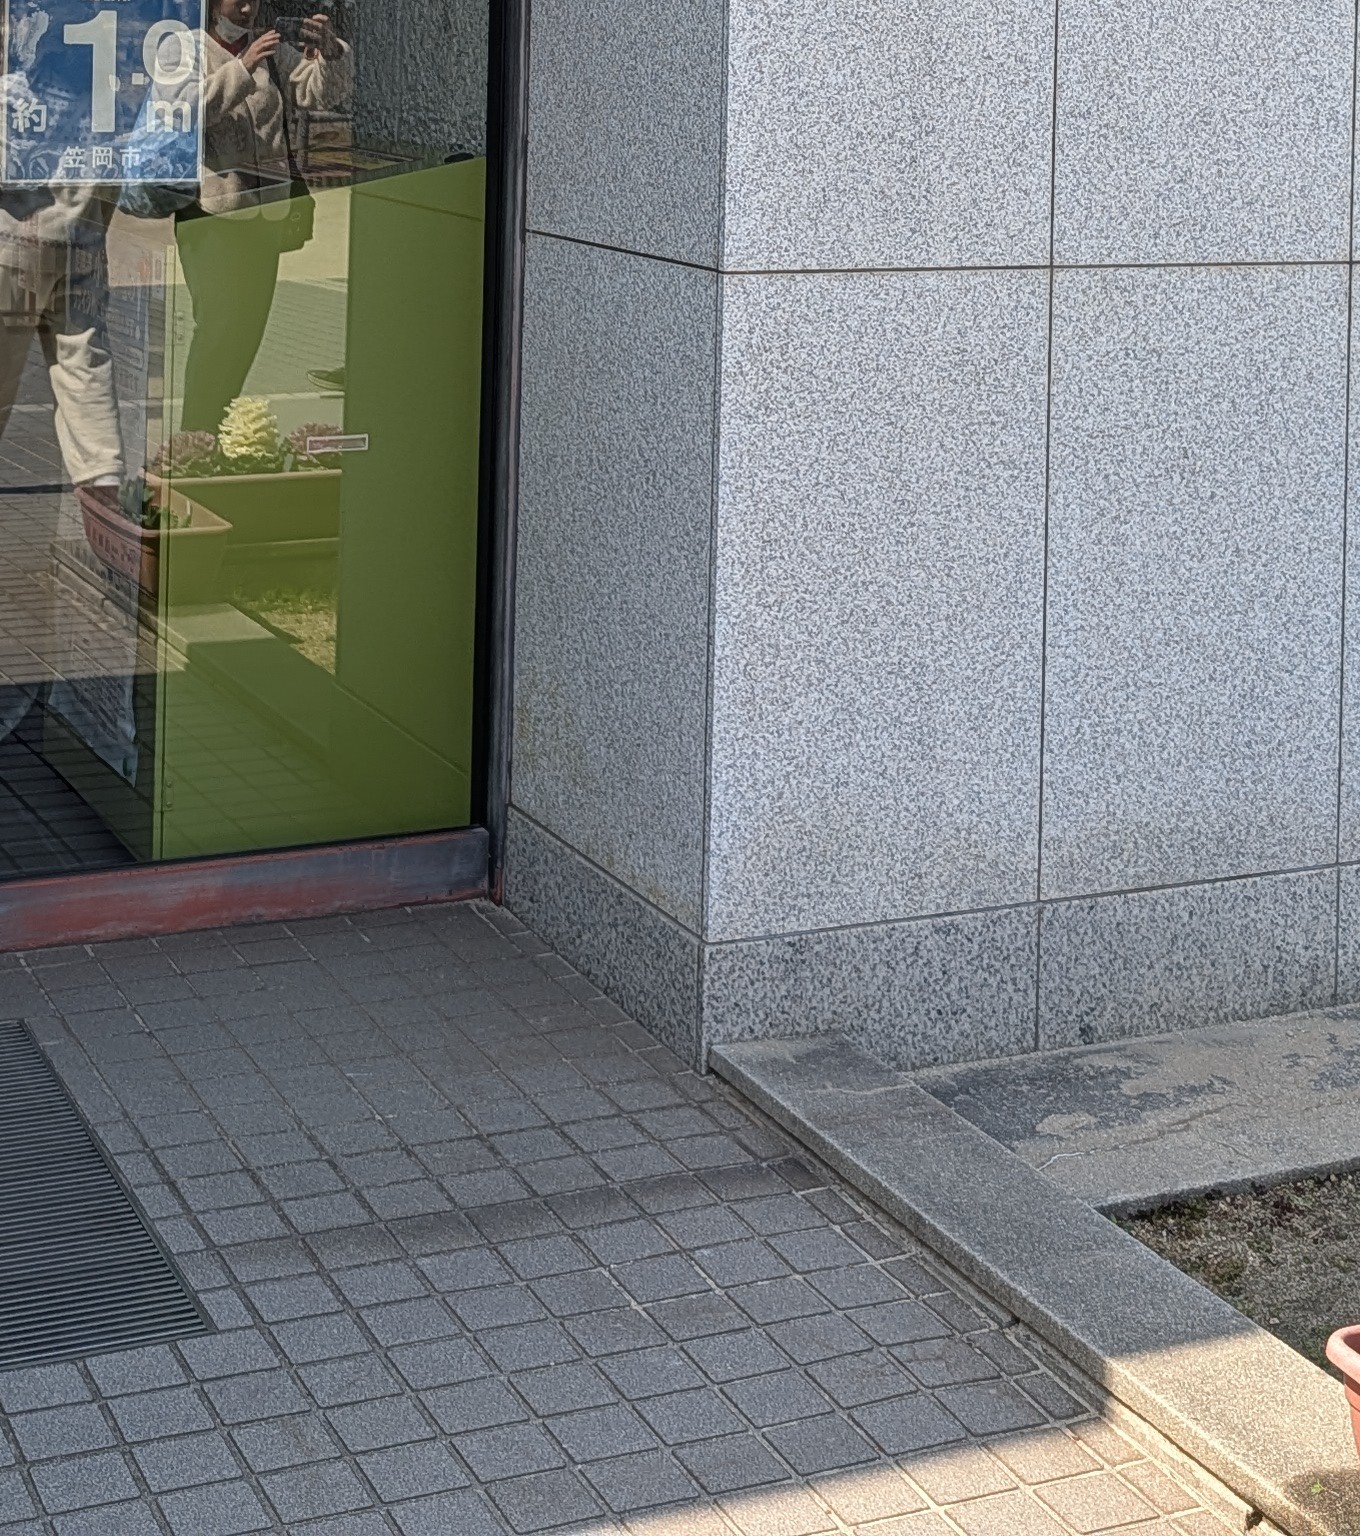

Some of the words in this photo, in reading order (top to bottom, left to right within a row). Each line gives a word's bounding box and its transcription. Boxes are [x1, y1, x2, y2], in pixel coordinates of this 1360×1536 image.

[11, 100, 48, 133] 約
[146, 100, 192, 133] m
[63, 145, 142, 169] 笠岡市
